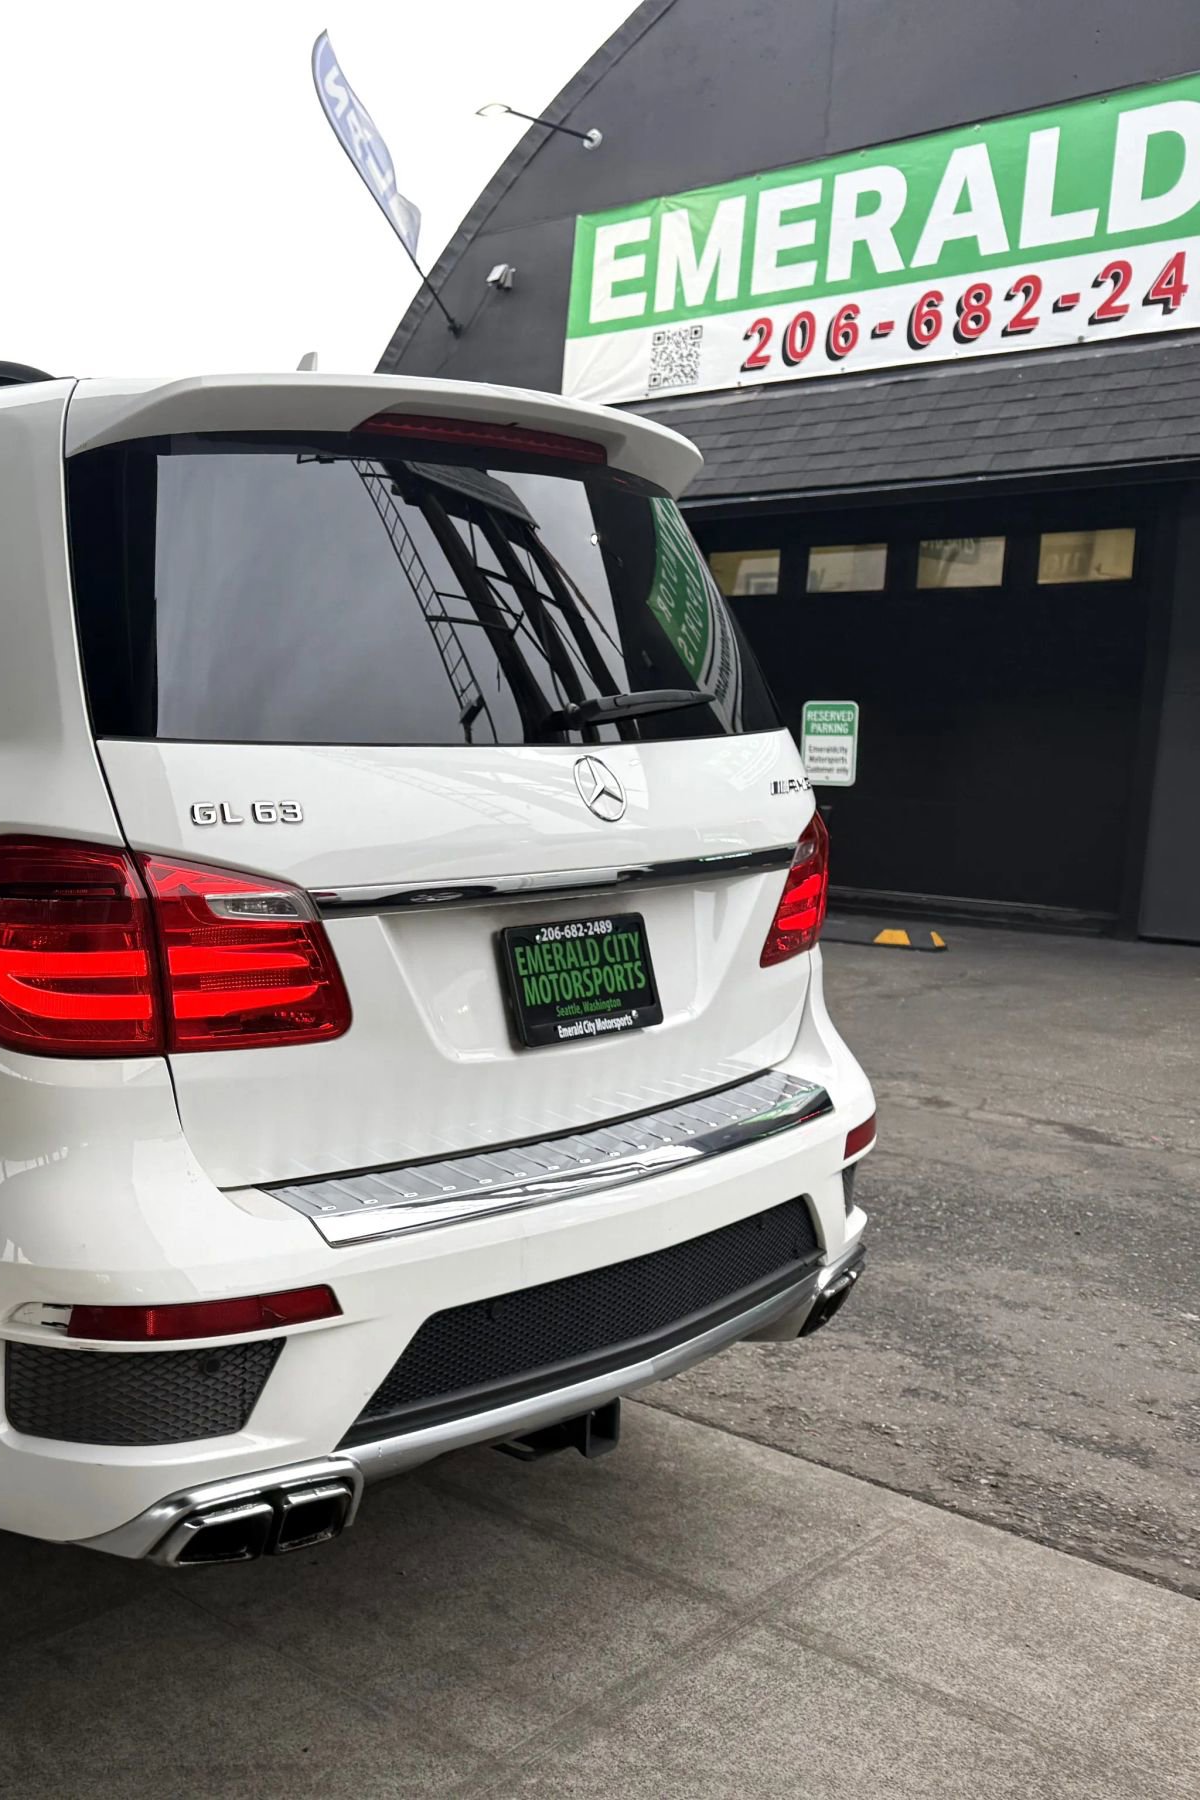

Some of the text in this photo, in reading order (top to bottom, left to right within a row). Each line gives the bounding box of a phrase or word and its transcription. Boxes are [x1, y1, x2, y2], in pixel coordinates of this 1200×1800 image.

[323, 64, 406, 225] SAL
[588, 99, 1200, 325] EMERALD
[740, 249, 1189, 373] 206-682-24
[806, 709, 854, 722] RESERVED
[810, 722, 849, 734] PARKING
[190, 799, 304, 825] GL 63
[540, 919, 613, 942] 206-682-2489
[514, 931, 641, 976] EMERALD CITY
[521, 960, 647, 1007] MOTORSPORTS
[555, 997, 622, 1018] Seattle, Washington
[557, 1012, 634, 1039] Emerald City Motorsports
